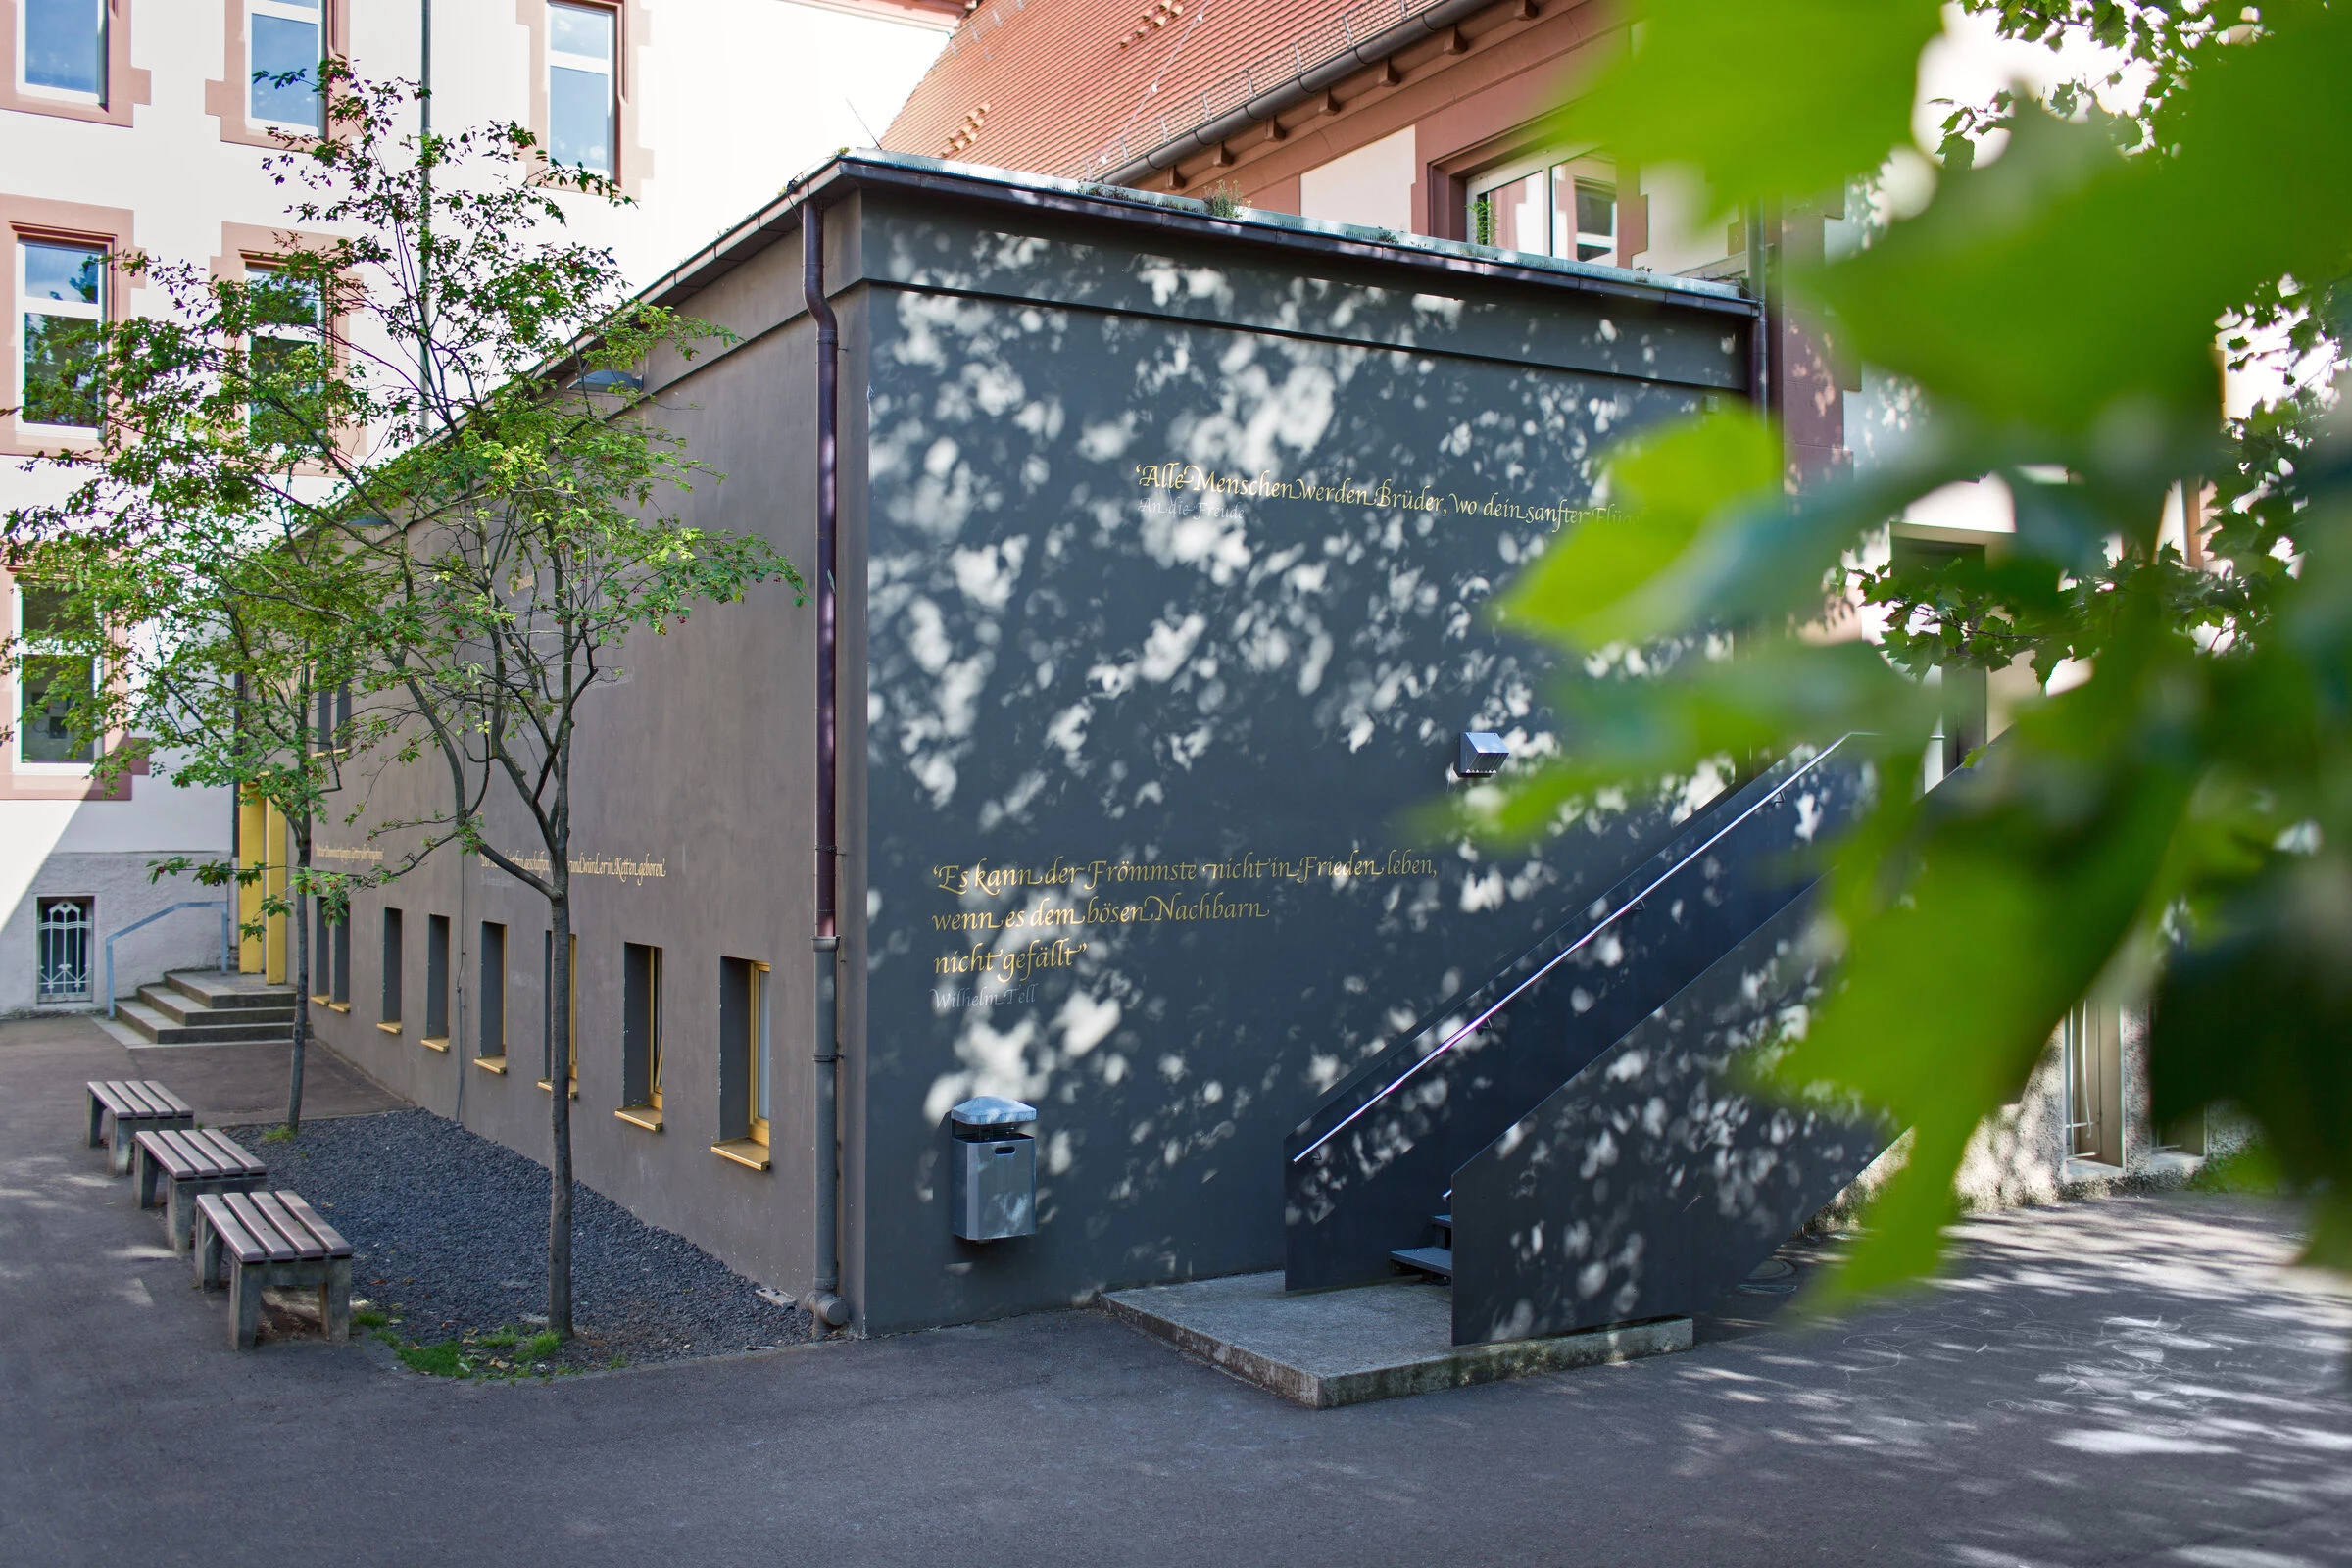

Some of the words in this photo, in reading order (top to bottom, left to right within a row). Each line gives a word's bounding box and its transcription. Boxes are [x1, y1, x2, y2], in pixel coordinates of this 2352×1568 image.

[1138, 497, 1168, 514] An
[1167, 497, 1196, 516] die
[1193, 501, 1245, 521] Freude
[1183, 465, 1301, 499] Menschen
[1298, 478, 1377, 506] werden
[1375, 478, 1447, 516] Brüder,
[1449, 493, 1478, 515] wo
[1483, 492, 1527, 518] dein
[1524, 498, 1590, 533] sanfter
[974, 858, 1042, 896] kann
[1044, 856, 1085, 885] der
[1084, 860, 1197, 890] Frömmste
[1202, 851, 1271, 879] nicht
[1270, 856, 1300, 878] in
[1296, 849, 1385, 884] Frieden
[1386, 849, 1438, 878] leben,
[931, 910, 1004, 931] wenn
[1004, 910, 1025, 928] es
[1030, 897, 1086, 927] dem
[1086, 896, 1154, 924] bösen
[1143, 892, 1270, 922] Nachbarn
[933, 942, 1004, 974] nicht
[929, 986, 1005, 1009] Wilhelm
[1004, 983, 1039, 1004] Tell
